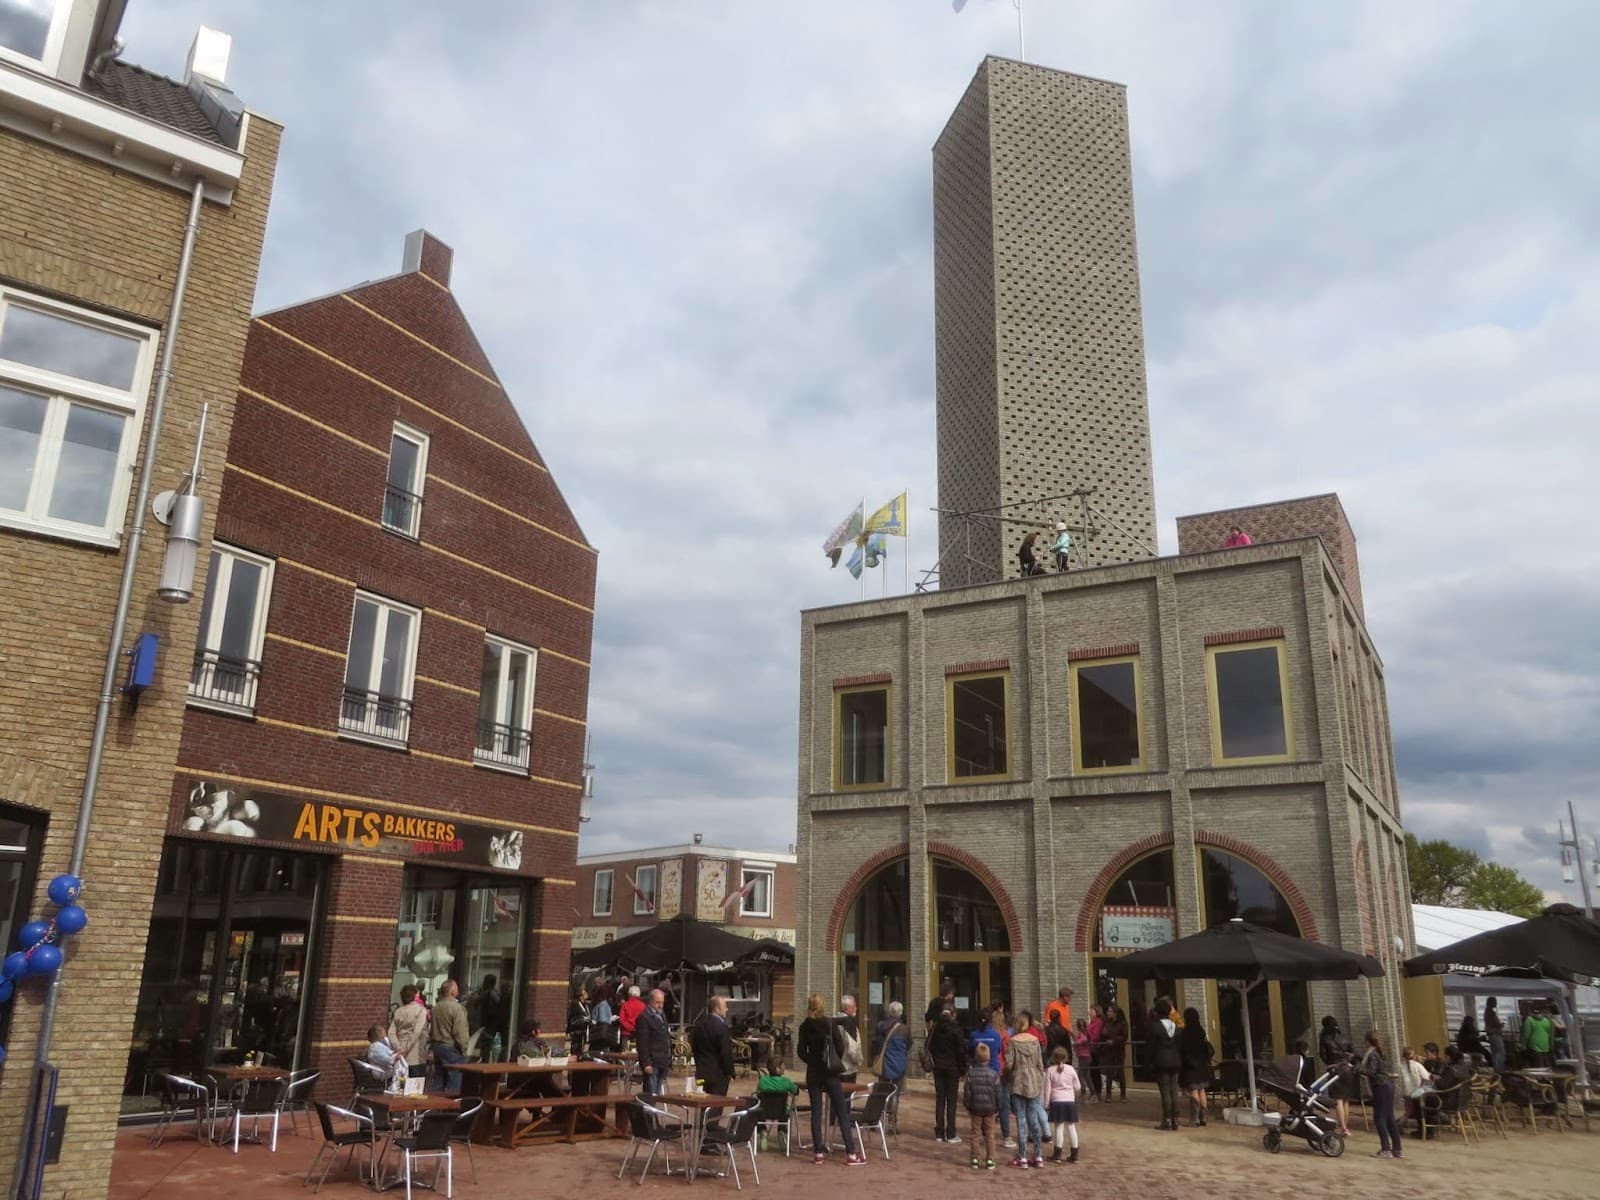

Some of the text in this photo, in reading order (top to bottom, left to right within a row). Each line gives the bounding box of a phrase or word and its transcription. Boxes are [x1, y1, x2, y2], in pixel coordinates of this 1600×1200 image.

[293, 803, 456, 848] ARTS BAKKERS
[1447, 963, 1487, 975] Hertog
